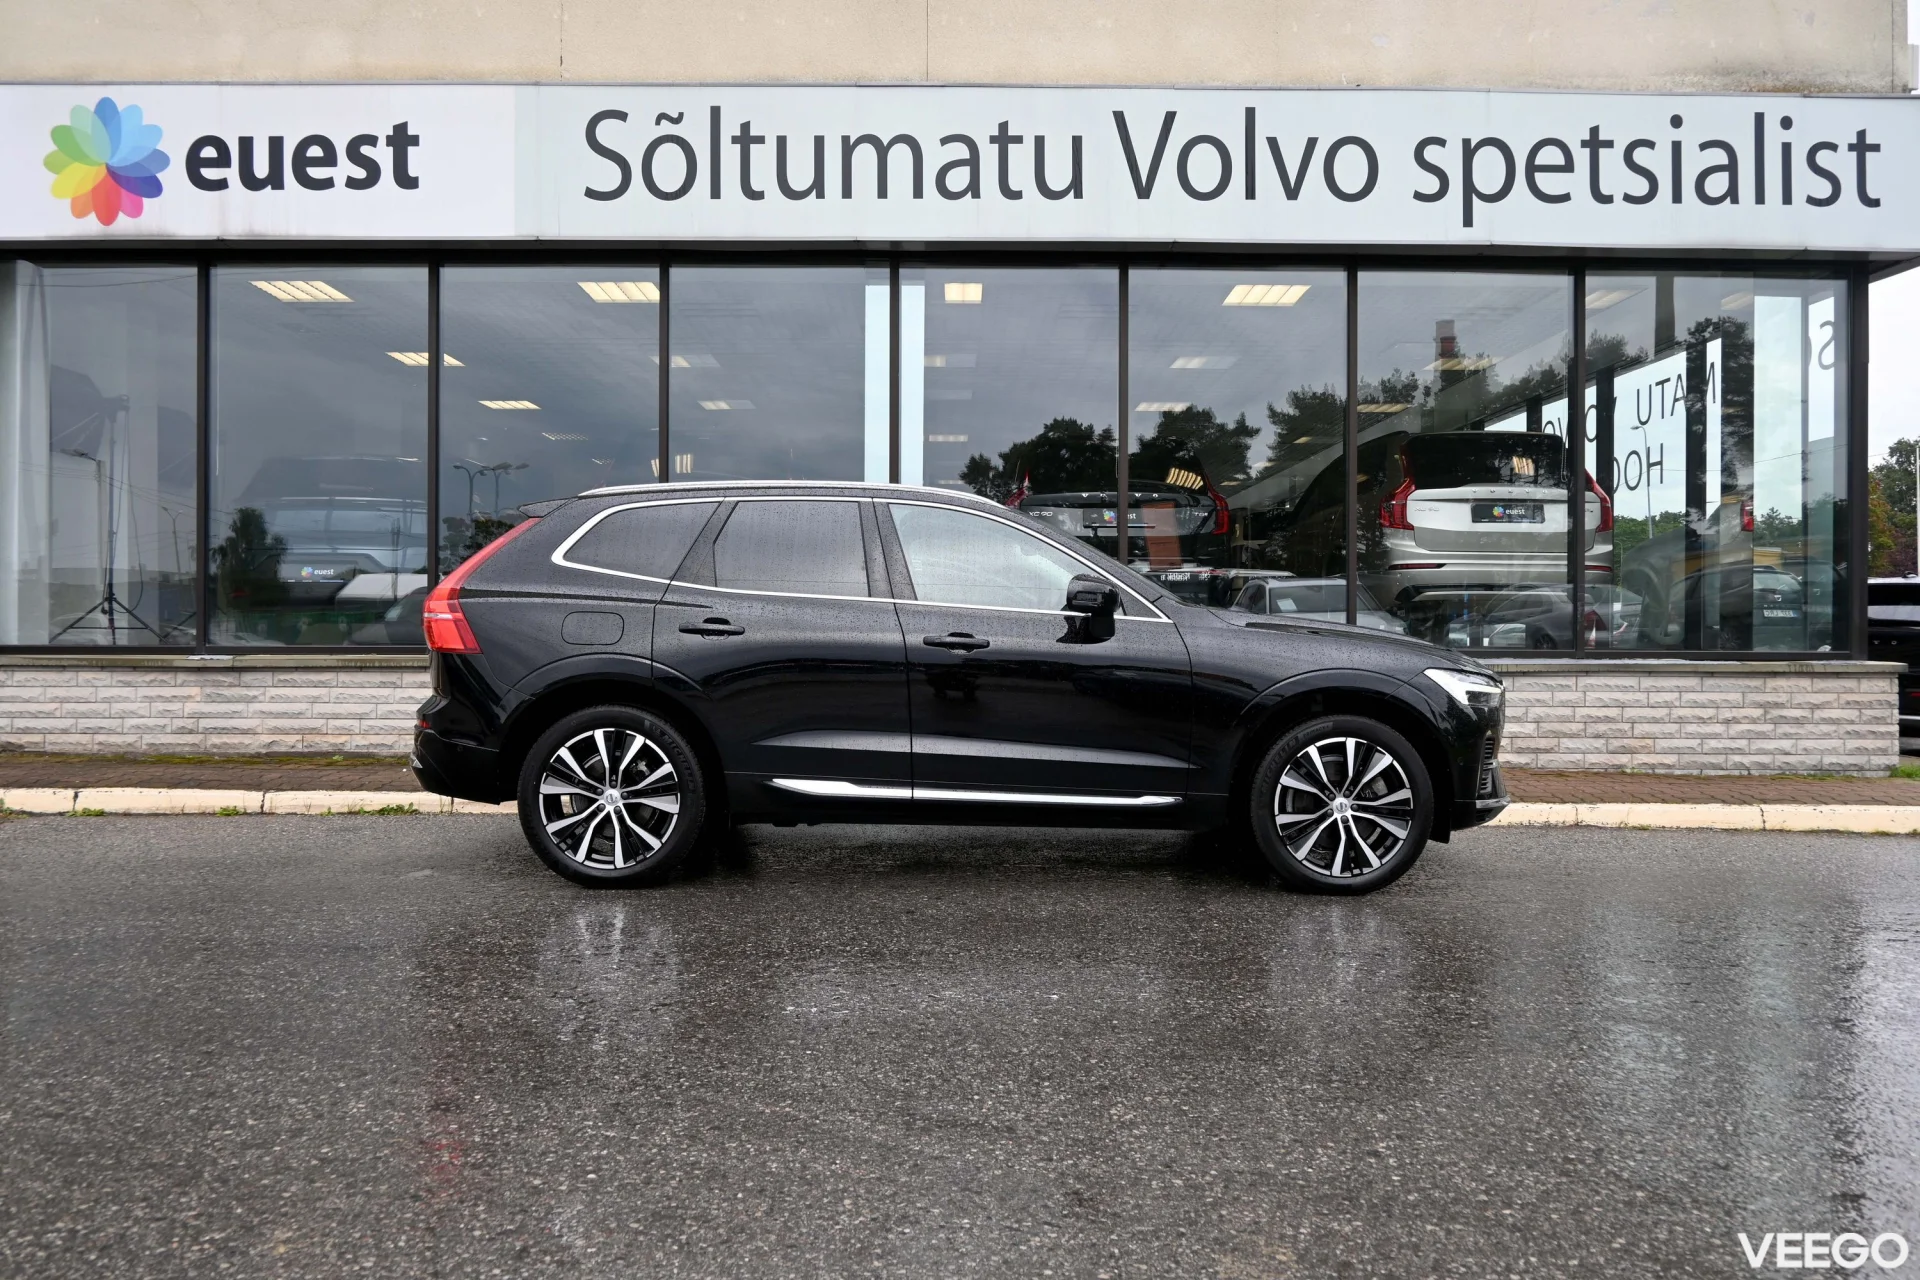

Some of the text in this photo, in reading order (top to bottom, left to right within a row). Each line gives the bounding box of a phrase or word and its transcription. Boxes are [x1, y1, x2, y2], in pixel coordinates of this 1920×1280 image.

[185, 122, 420, 192] euest
[584, 105, 1881, 228] Sõltumatu Volvo spetsialist
[1505, 507, 1525, 515] euest
